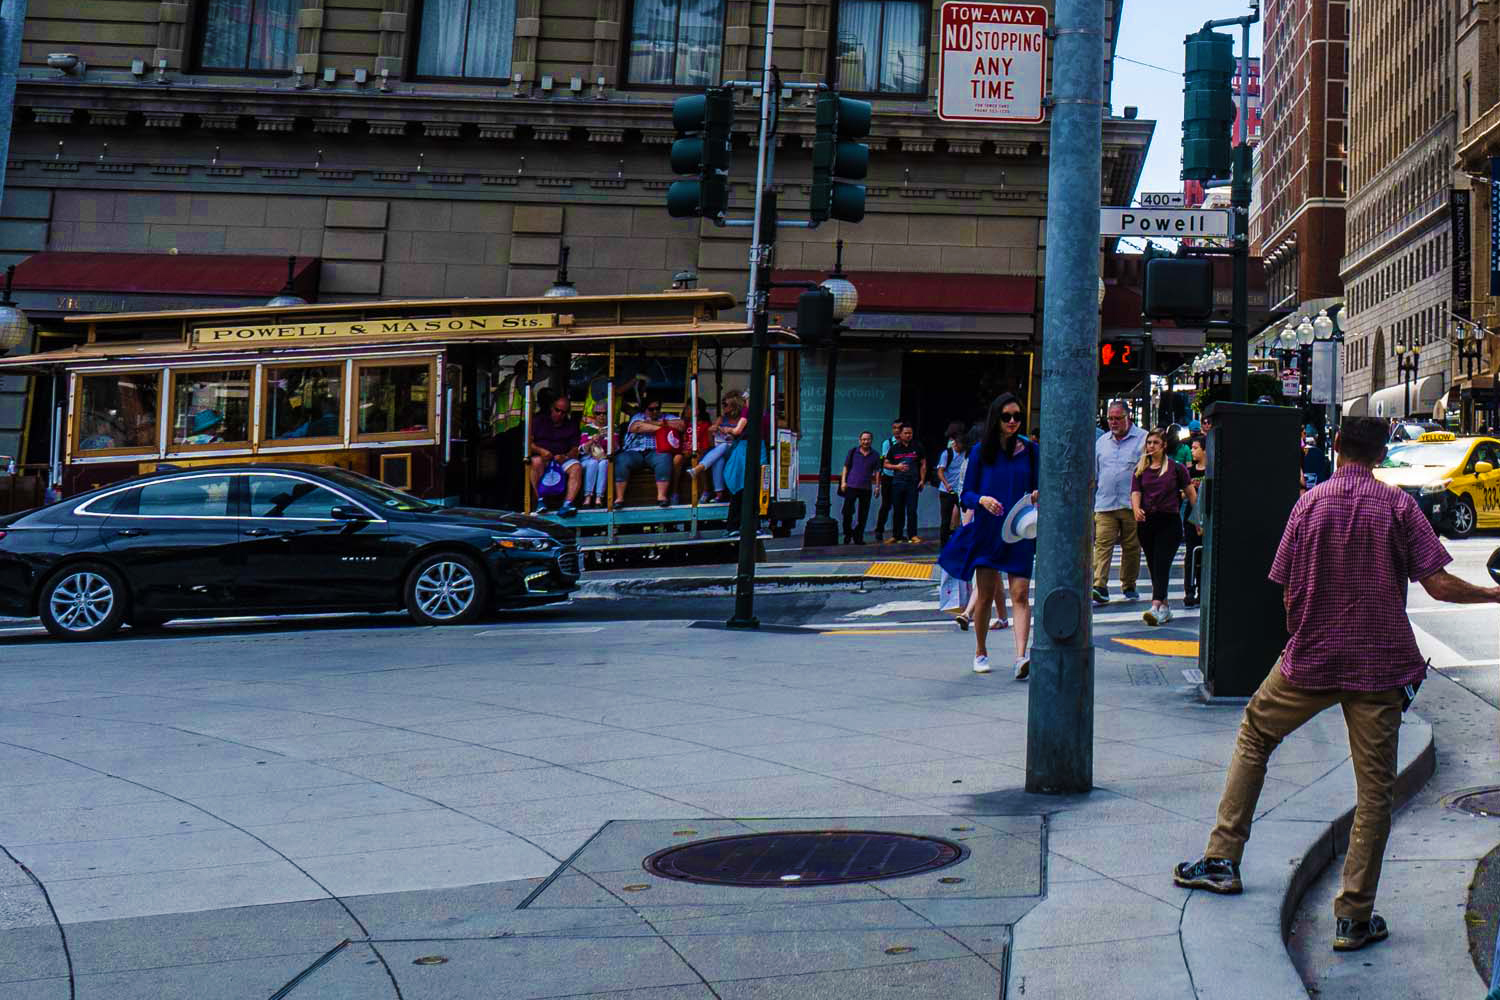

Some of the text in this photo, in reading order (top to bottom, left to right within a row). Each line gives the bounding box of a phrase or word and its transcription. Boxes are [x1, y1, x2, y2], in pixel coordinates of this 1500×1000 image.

[950, 6, 1036, 23] TOW-AWAY
[945, 23, 1041, 52] NO STOPPING
[974, 56, 1013, 77] ANY
[970, 80, 1015, 100] TIME
[1143, 194, 1170, 205] 400
[1121, 214, 1204, 231] Powell
[213, 317, 544, 341] POWELL & MASON Sts.
[1121, 345, 1131, 363] 2
[1421, 433, 1451, 442] YELLOW
